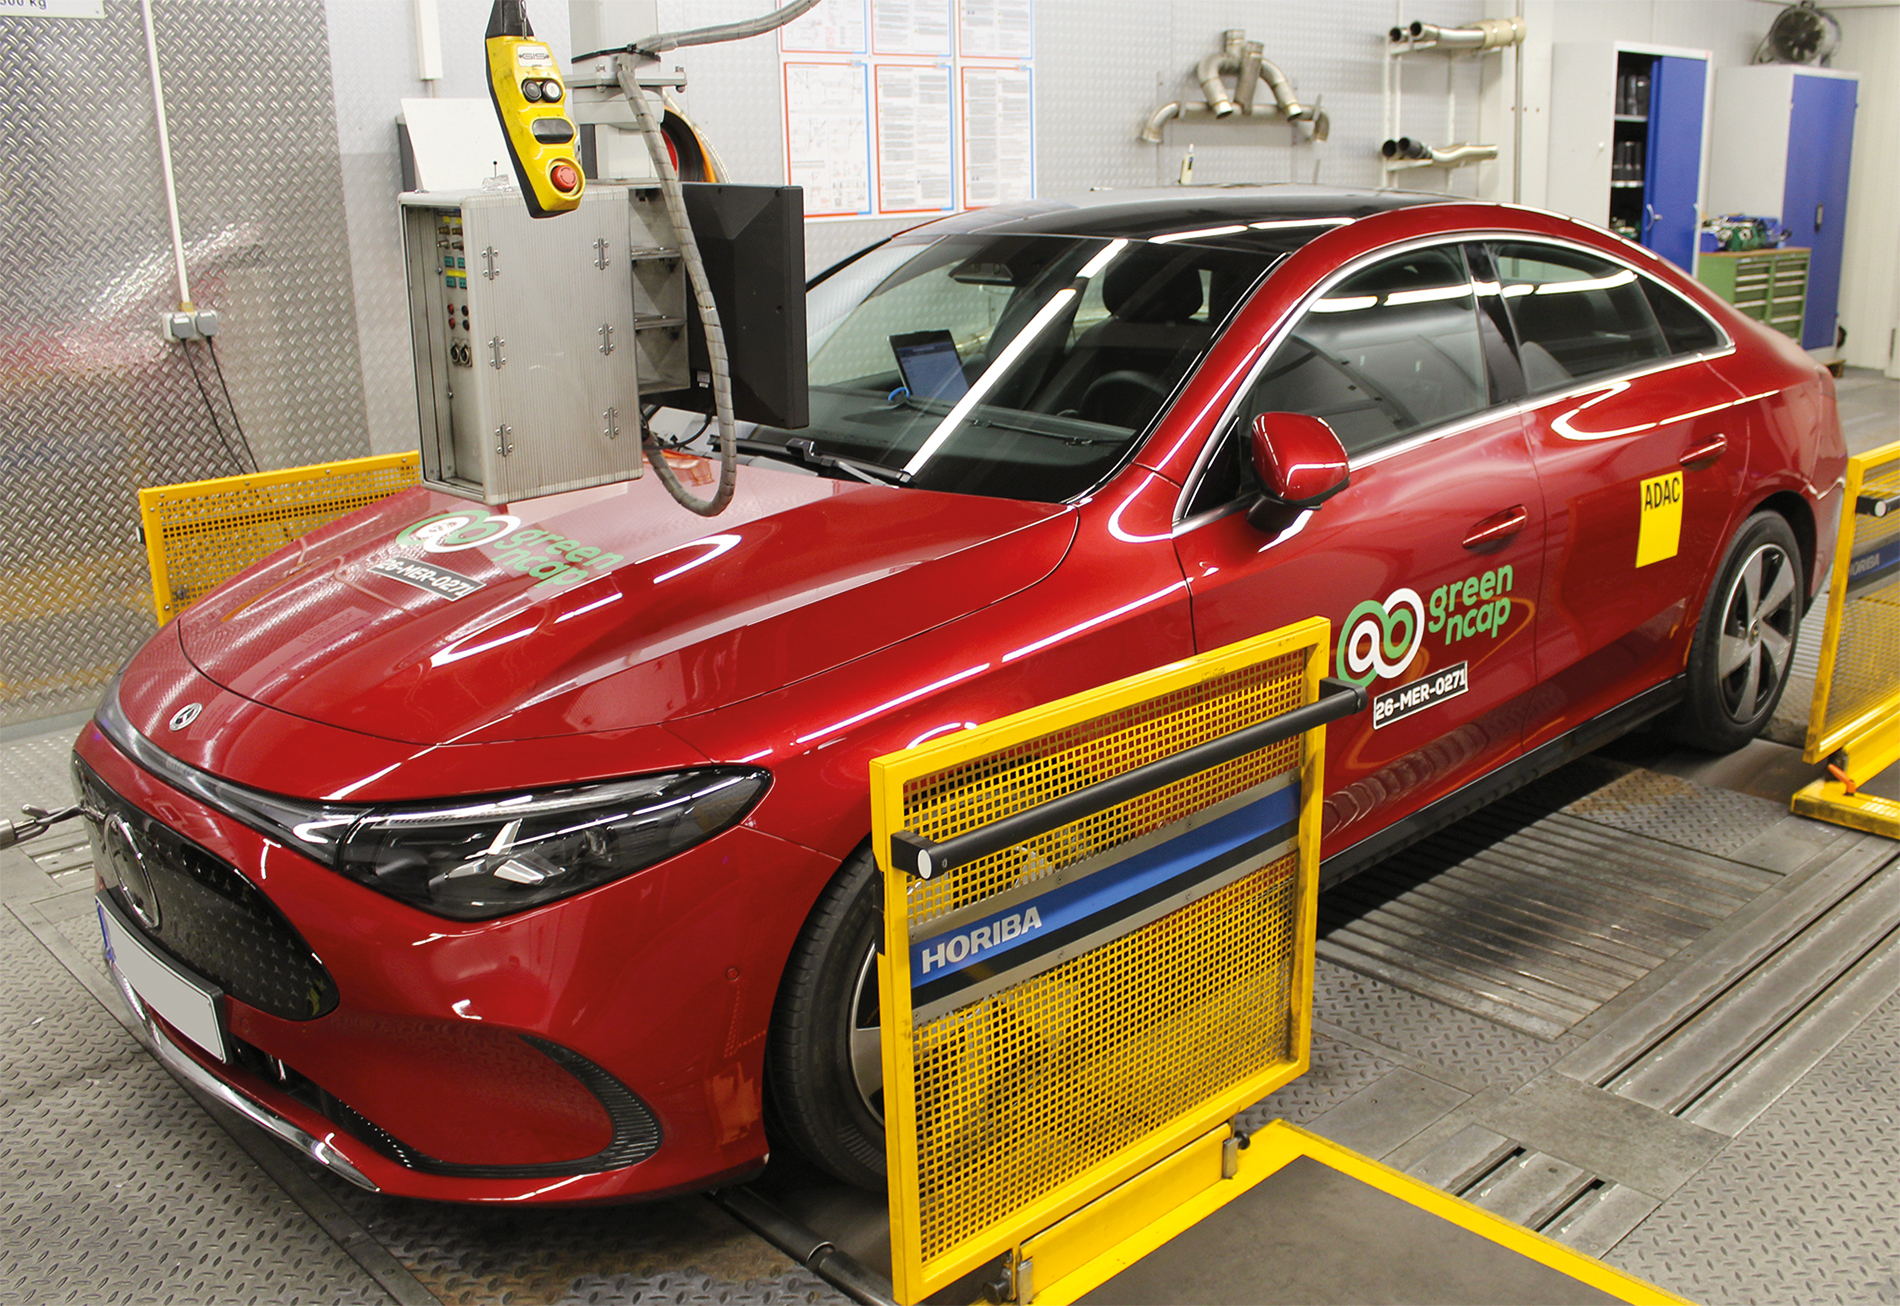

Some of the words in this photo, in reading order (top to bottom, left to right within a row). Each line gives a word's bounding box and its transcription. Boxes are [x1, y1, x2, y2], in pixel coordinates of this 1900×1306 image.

[1644, 477, 1680, 512] ADAC
[491, 548, 589, 589] ncap
[493, 528, 625, 570] green
[376, 556, 478, 597] 26-MER-0271
[1428, 564, 1514, 634] green
[1445, 597, 1511, 646] ncap
[1375, 668, 1467, 721] 26-MER-0271
[922, 906, 1042, 974] HORIBA
